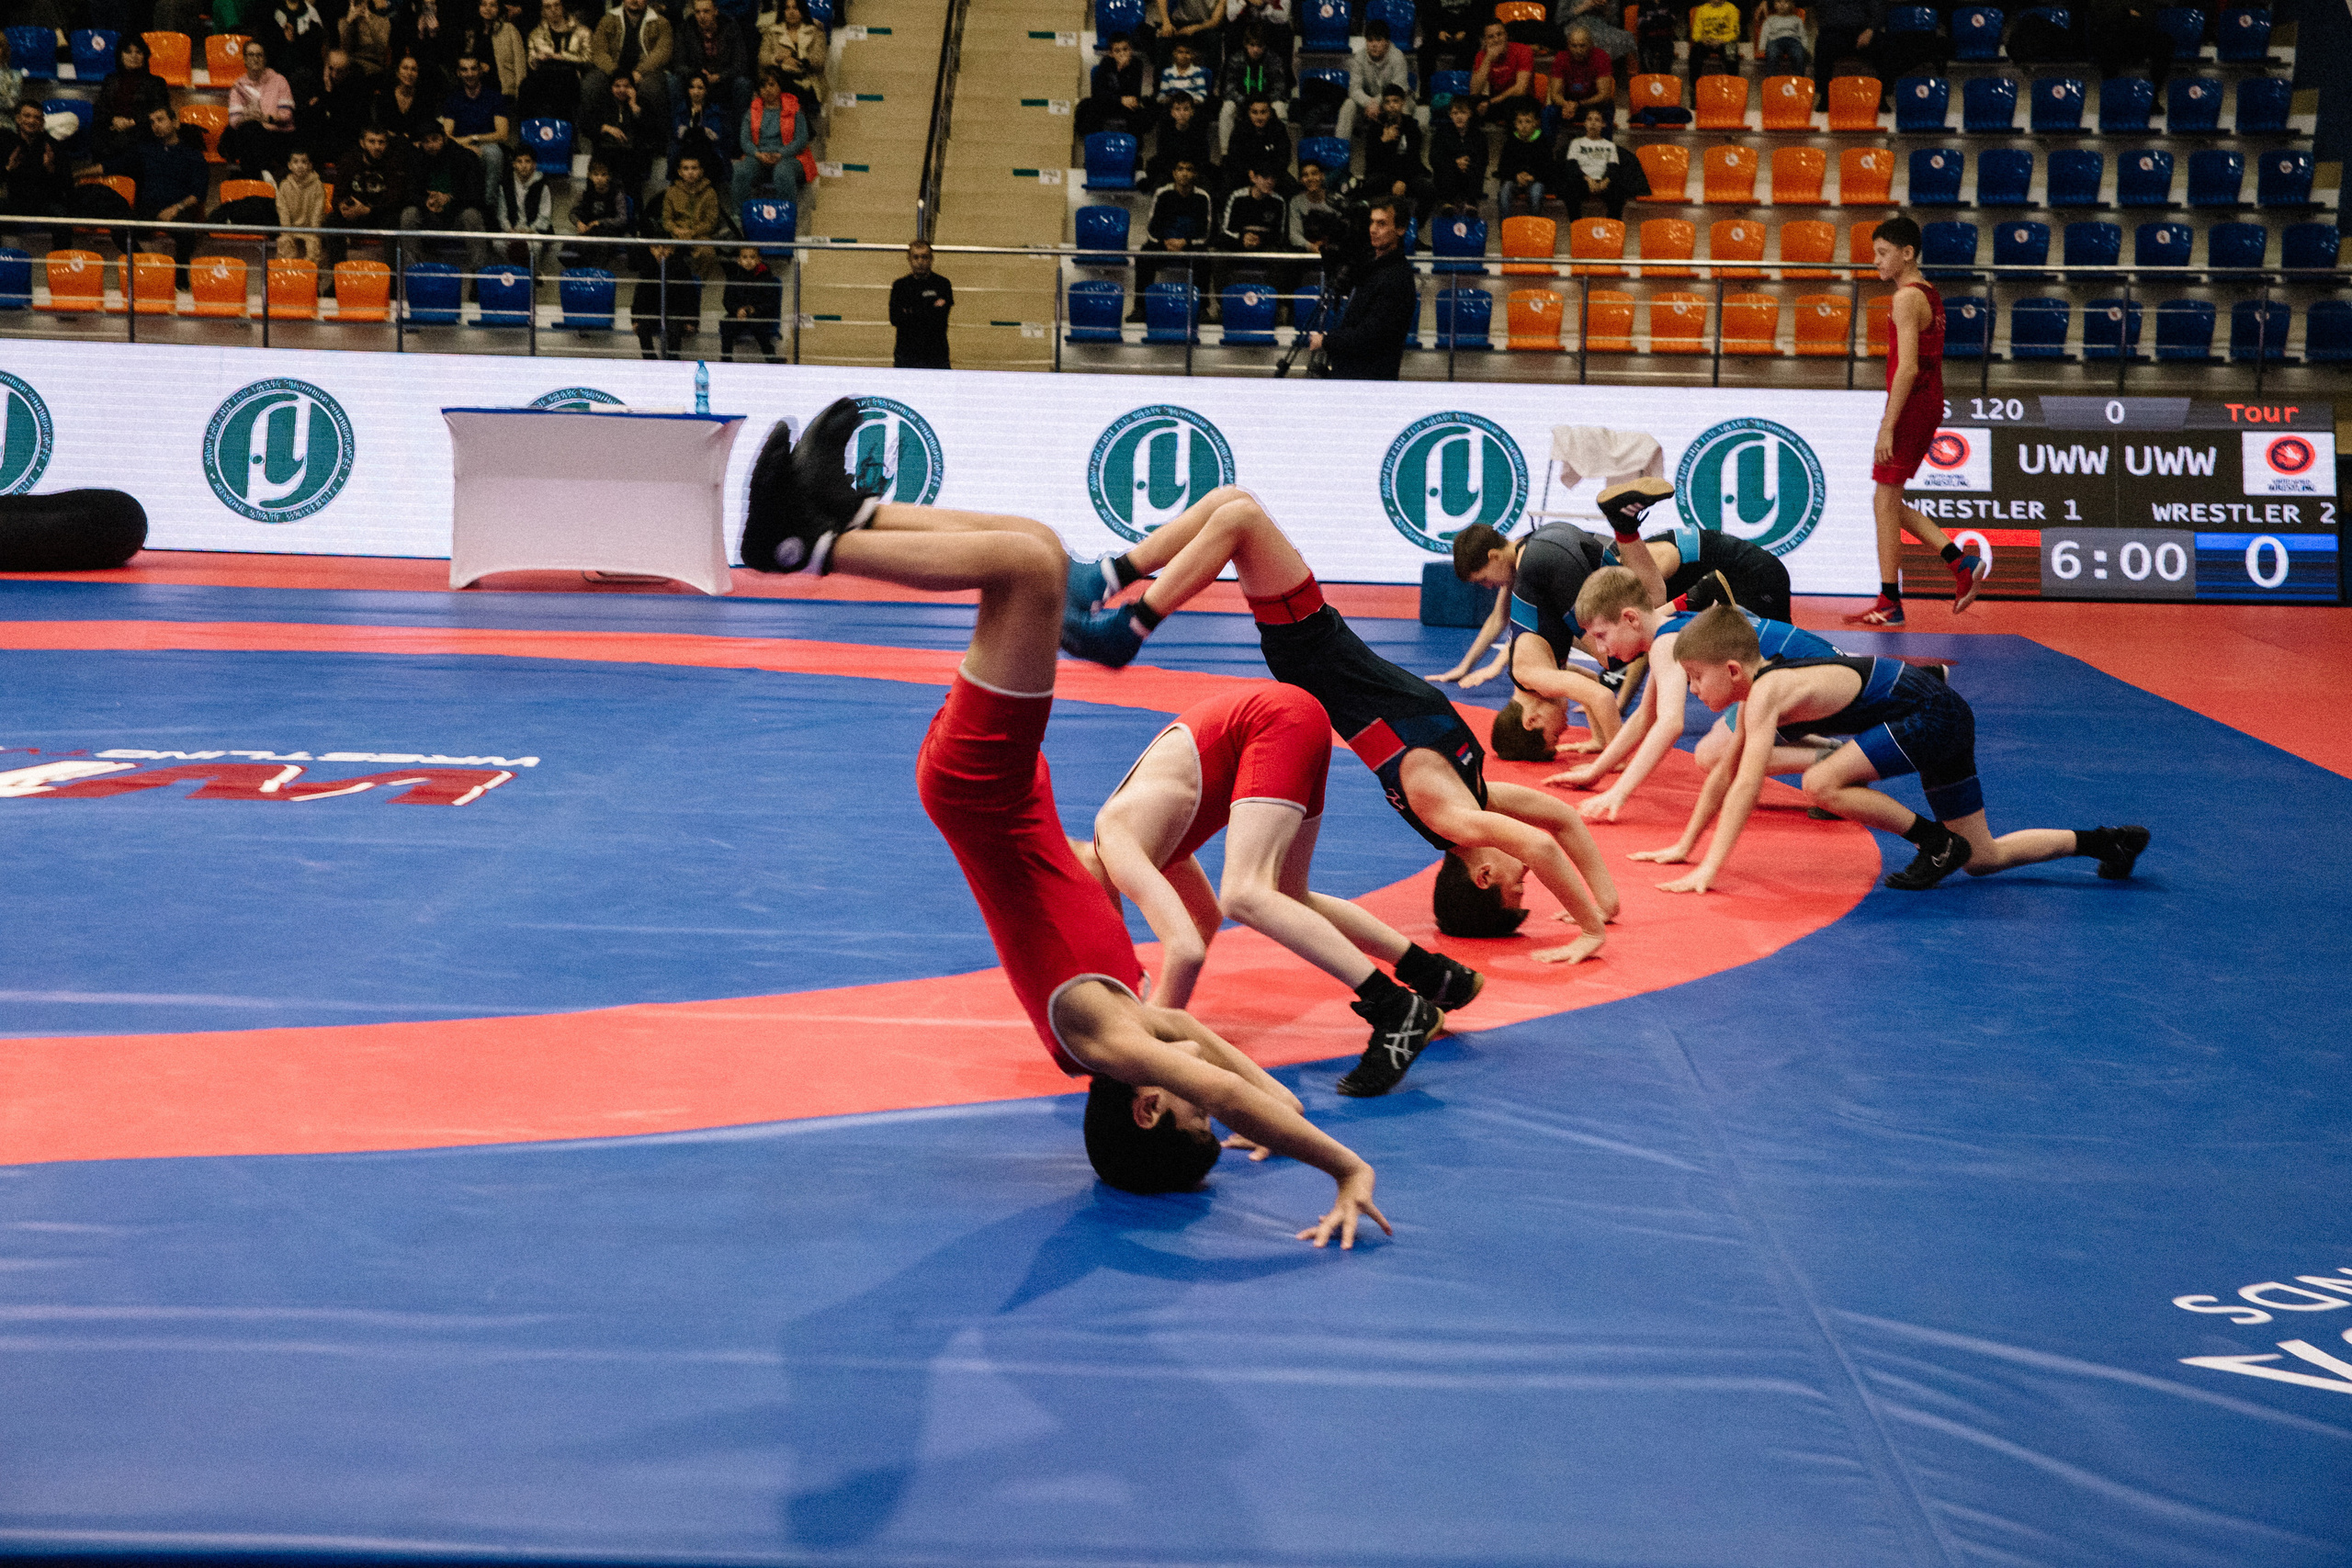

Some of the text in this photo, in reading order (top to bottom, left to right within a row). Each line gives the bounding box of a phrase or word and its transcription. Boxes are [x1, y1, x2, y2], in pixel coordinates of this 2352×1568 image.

[1971, 398, 2024, 421] 120
[2105, 400, 2126, 424] 0
[2224, 403, 2300, 423] Tour
[2018, 443, 2109, 475] UWW
[2125, 445, 2217, 477] UWW
[2064, 499, 2083, 521] 1
[2152, 502, 2336, 525] WRESTLER 2
[2051, 540, 2188, 581] 6:00
[2245, 535, 2290, 589] 0
